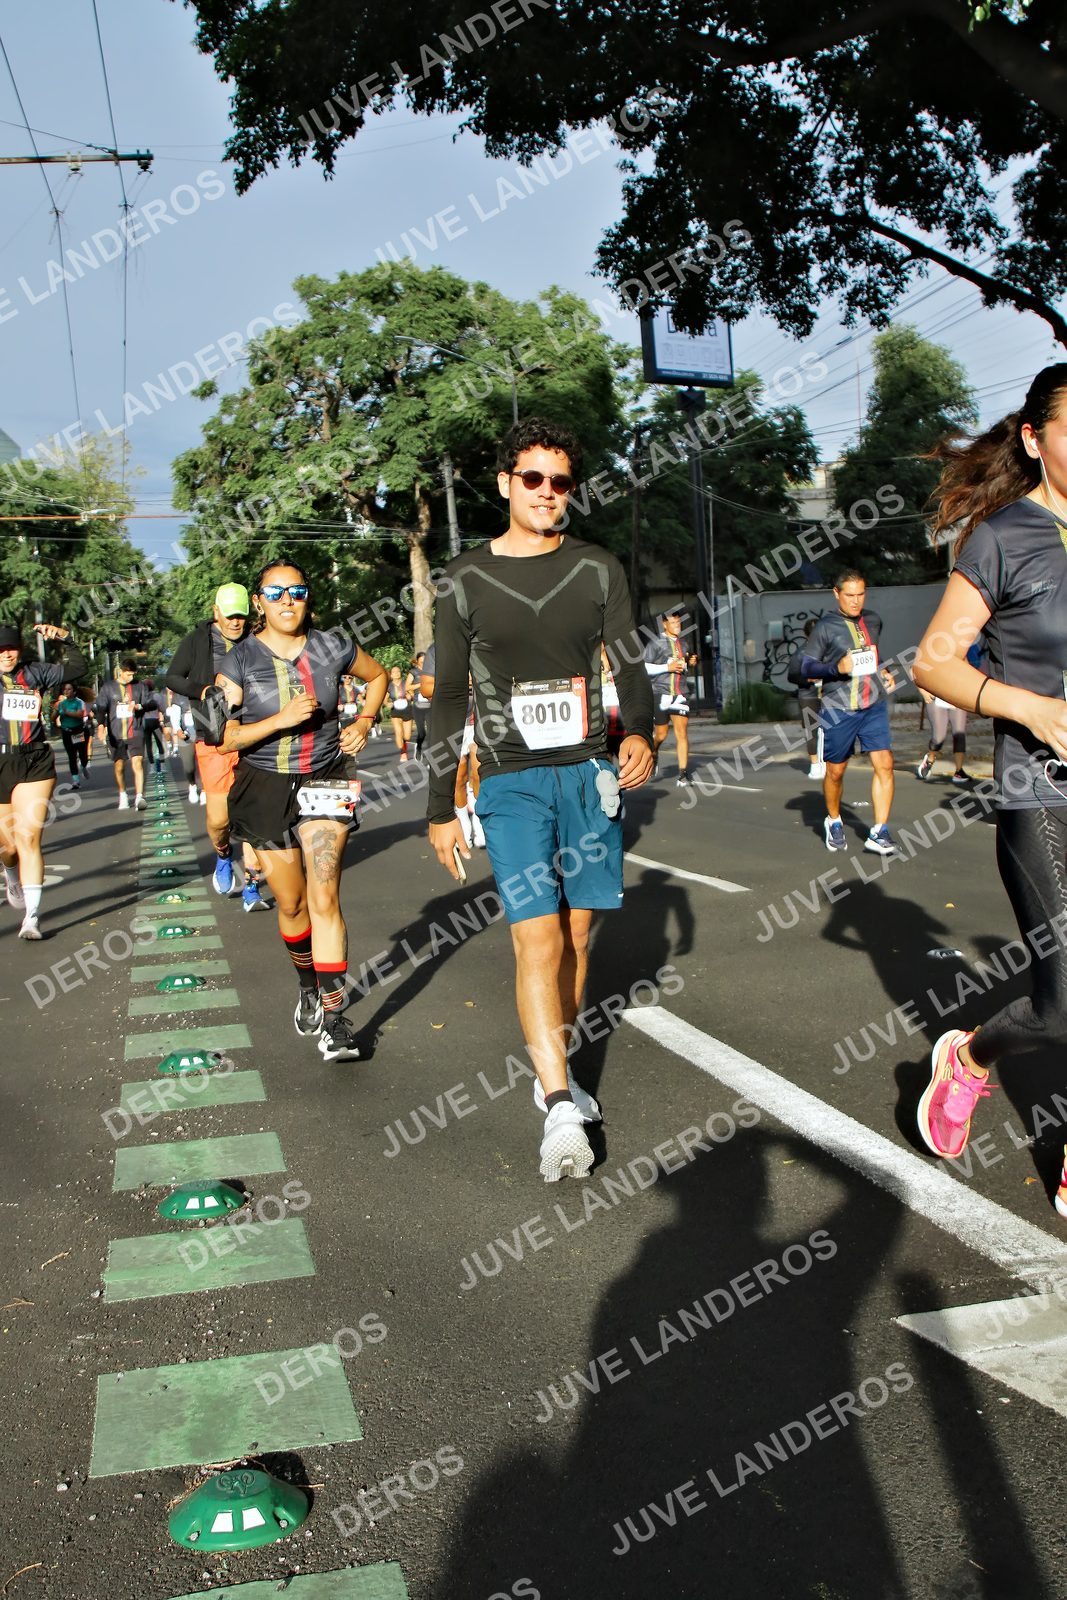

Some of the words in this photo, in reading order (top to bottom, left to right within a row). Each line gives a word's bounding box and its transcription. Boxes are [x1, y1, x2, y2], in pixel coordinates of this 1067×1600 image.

[855, 654, 874, 666] 2089
[6, 698, 36, 710] 13405
[521, 701, 571, 725] 8010
